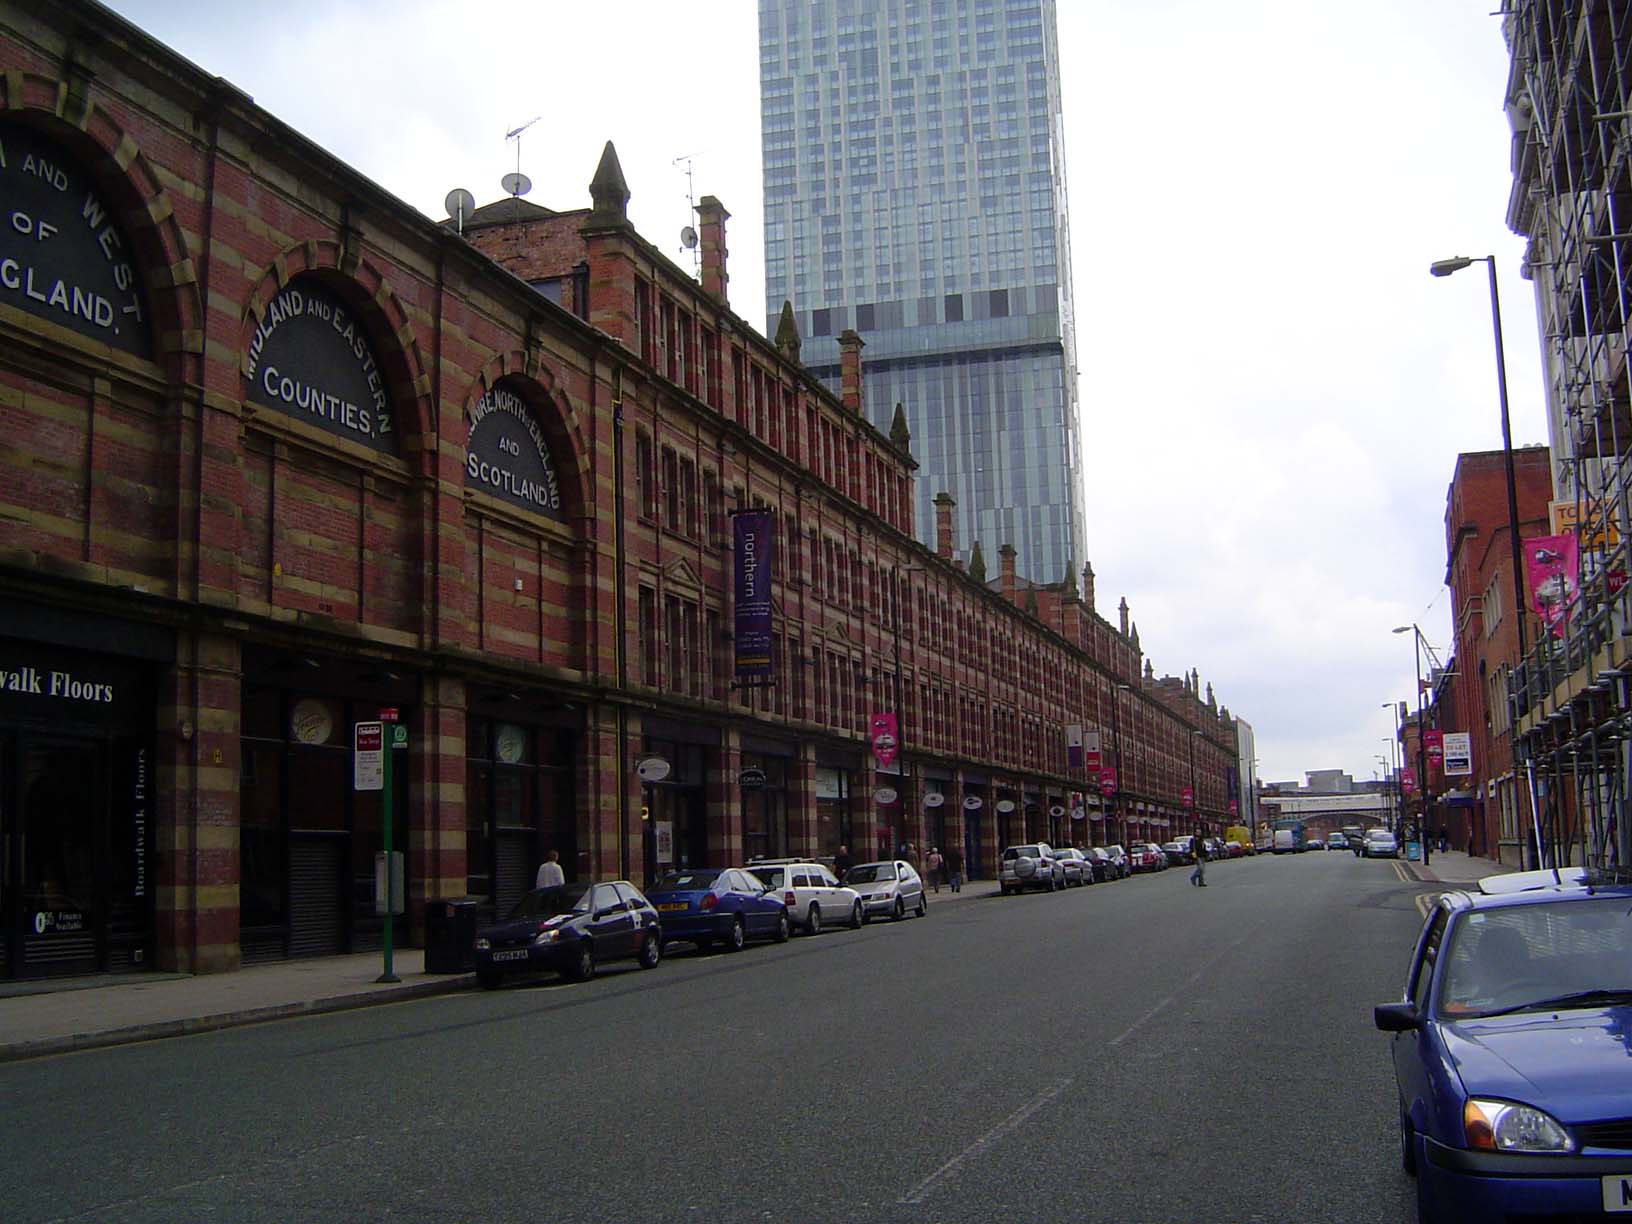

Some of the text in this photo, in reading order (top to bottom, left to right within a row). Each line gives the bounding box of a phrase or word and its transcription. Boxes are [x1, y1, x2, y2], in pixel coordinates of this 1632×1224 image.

[12, 211, 58, 241] OF
[23, 153, 143, 323] AND WEST
[248, 290, 392, 433] MIDLAND AND EASTERN
[494, 390, 528, 423] NORTH
[499, 437, 520, 456] AND
[744, 532, 759, 598] northern
[50, 671, 113, 702] Floors
[135, 748, 145, 896] Boardwalk Floors
